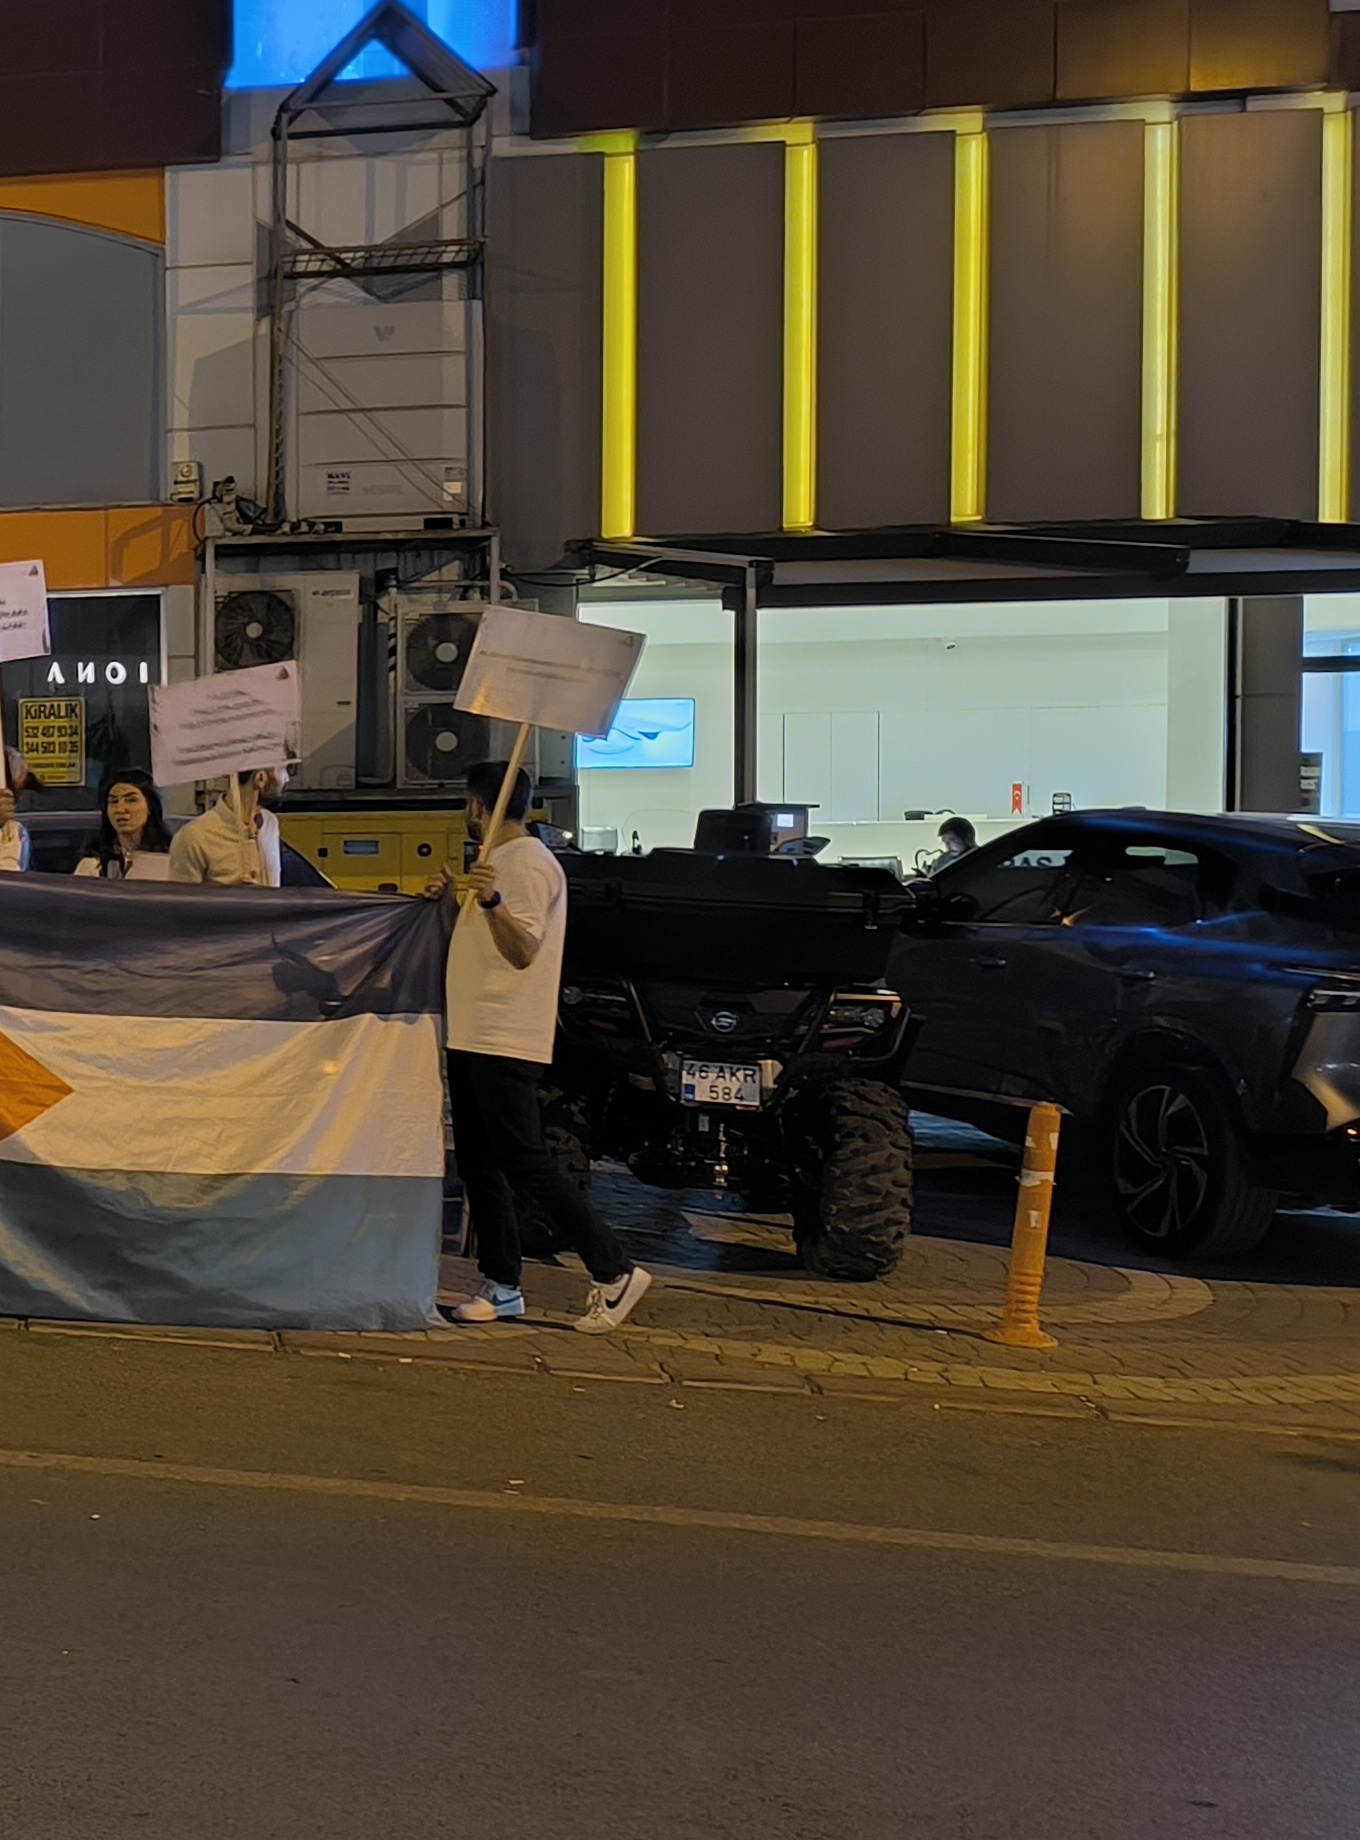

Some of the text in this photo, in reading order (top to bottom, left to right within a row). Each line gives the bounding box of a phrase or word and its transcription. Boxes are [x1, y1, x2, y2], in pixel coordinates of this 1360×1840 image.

[686, 1063, 757, 1084] 46 AKR
[709, 1085, 745, 1102] 584
